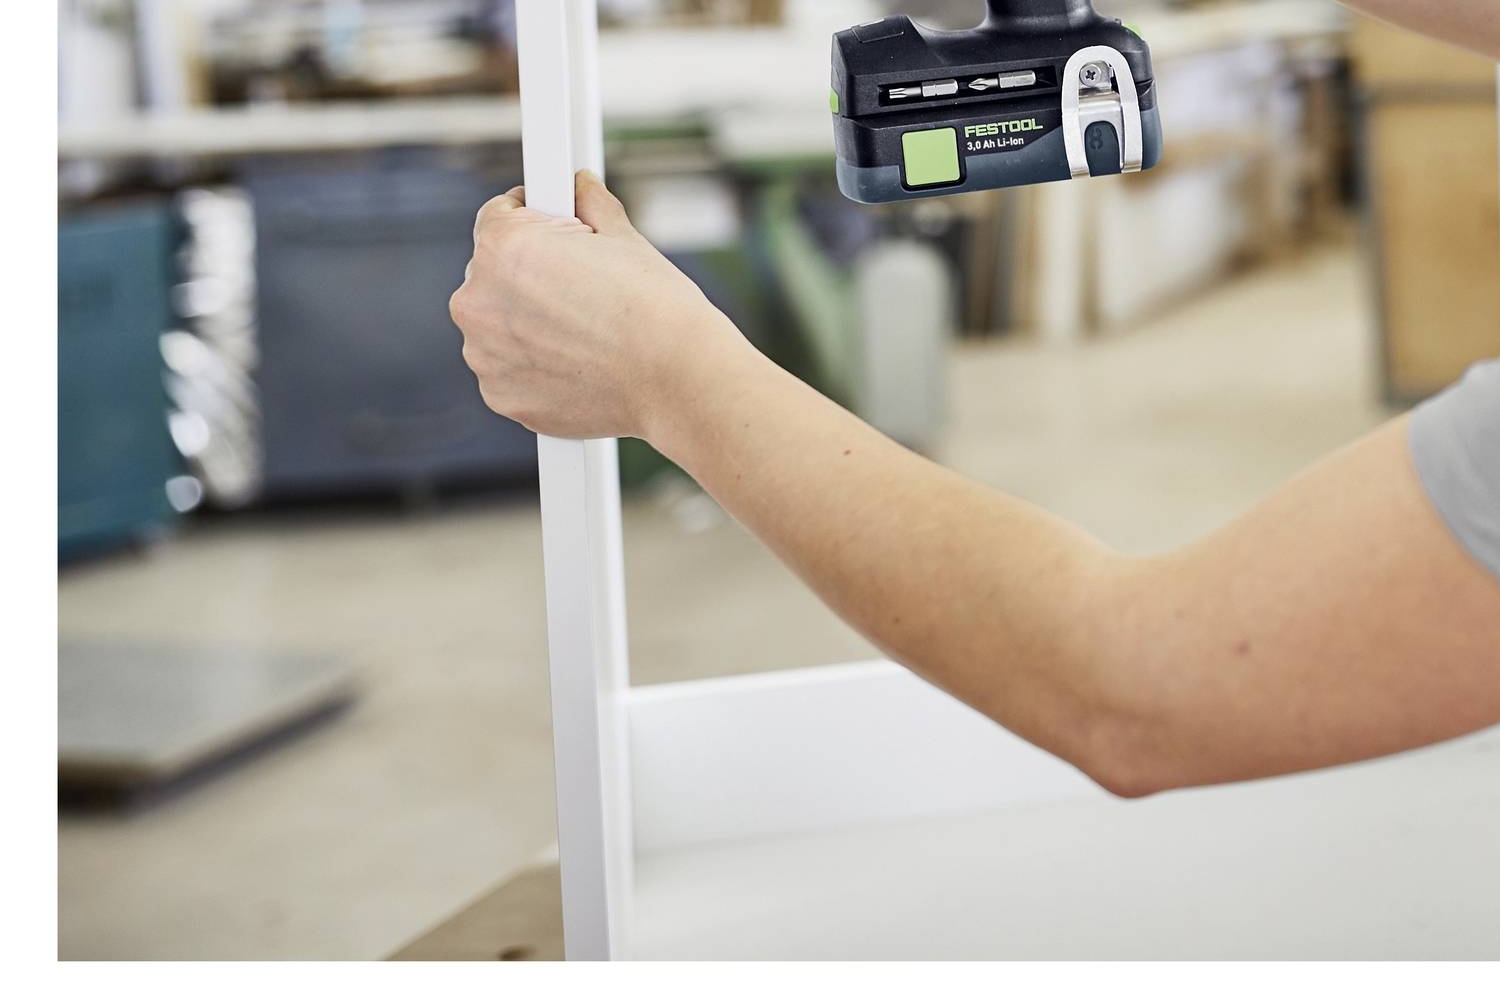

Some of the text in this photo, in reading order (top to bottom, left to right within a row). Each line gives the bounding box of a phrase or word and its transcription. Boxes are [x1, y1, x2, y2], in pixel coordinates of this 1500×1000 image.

[964, 118, 1044, 138] FESTOOL
[967, 137, 1024, 152] 3,0 Ah Li-Ion
